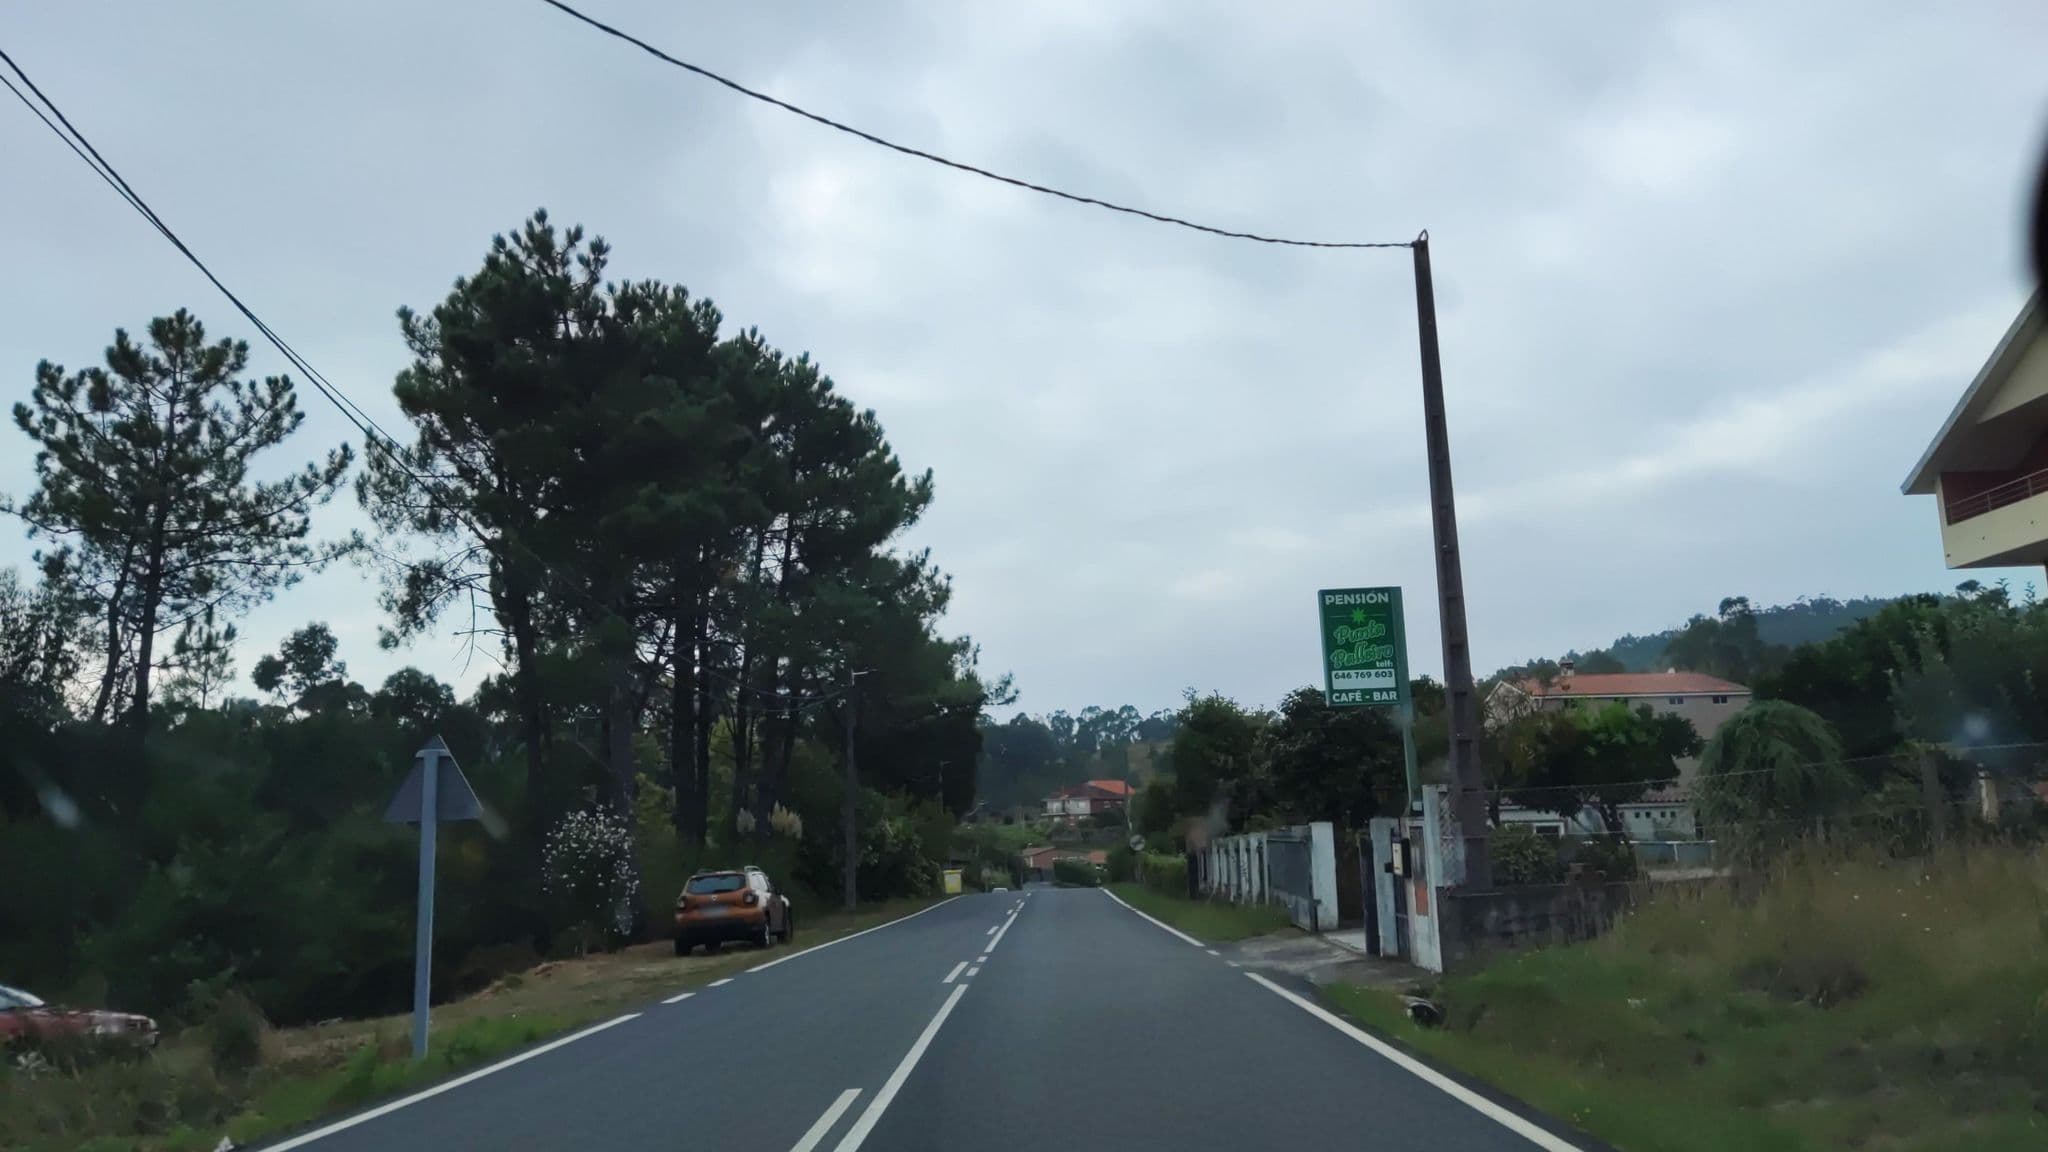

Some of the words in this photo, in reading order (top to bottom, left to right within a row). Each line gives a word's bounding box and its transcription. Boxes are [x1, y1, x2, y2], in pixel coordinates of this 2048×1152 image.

[1325, 591, 1389, 605] PENSIÓN
[1334, 671, 1352, 680] 646
[1354, 671, 1372, 680] 769
[1375, 670, 1393, 679] 603
[1332, 690, 1362, 703] CAFÉ
[1373, 690, 1398, 702] BAR
